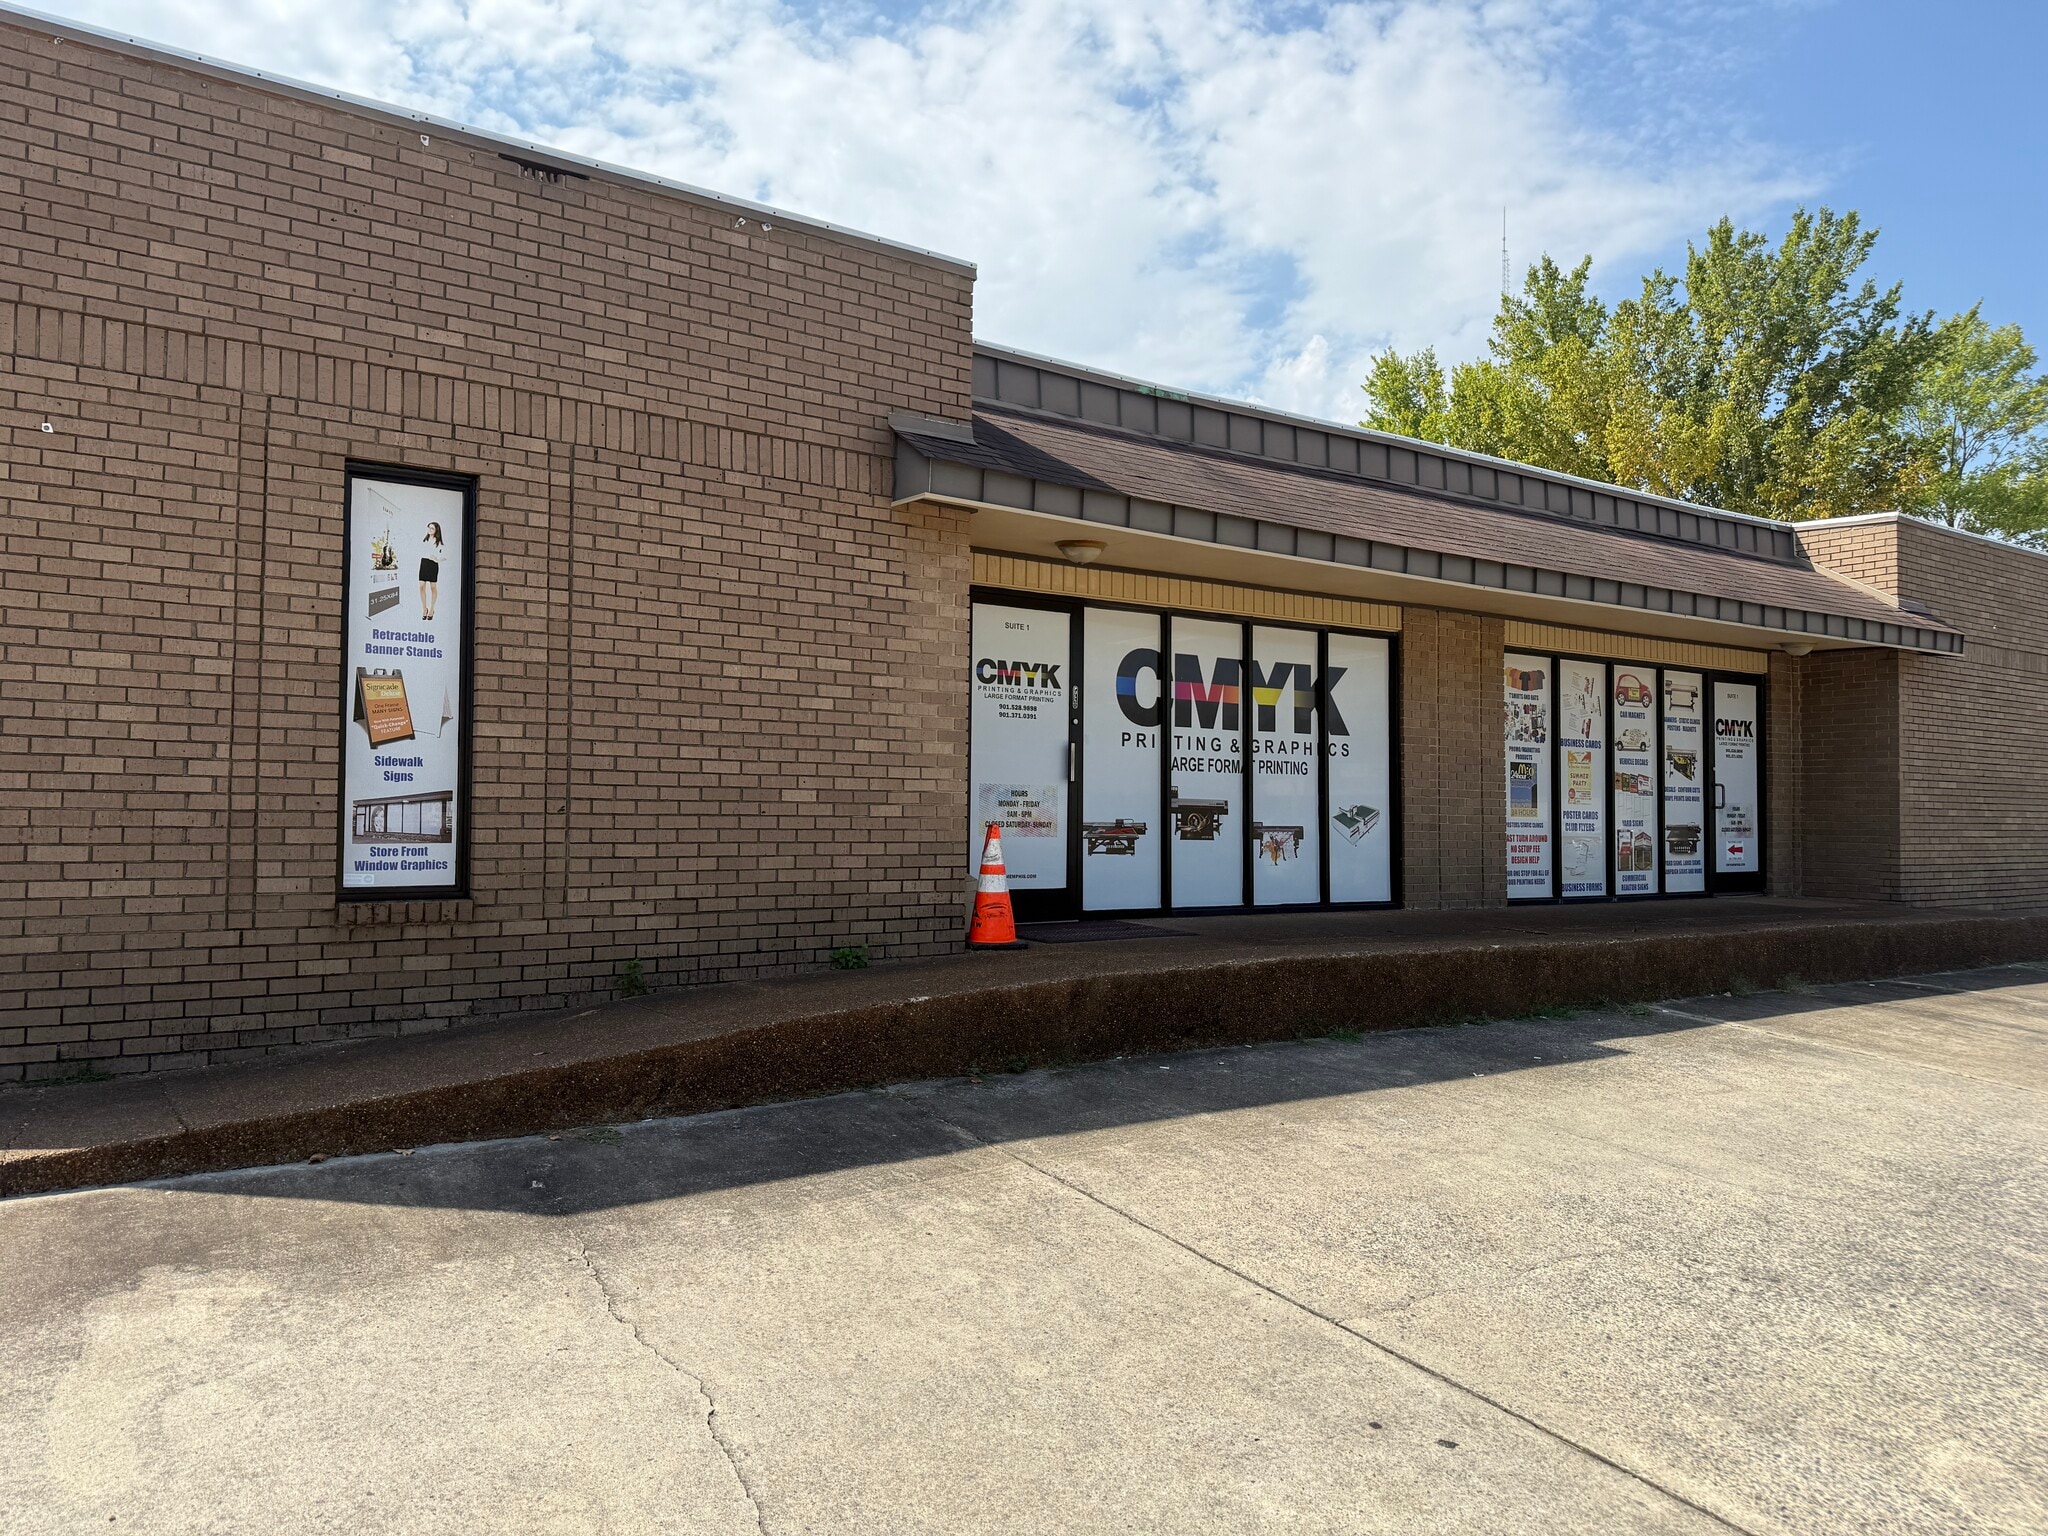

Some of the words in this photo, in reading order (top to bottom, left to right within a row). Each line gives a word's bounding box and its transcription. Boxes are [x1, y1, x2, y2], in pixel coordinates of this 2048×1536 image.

[1004, 622, 1025, 631] SUITE
[372, 628, 435, 643] Retractable
[365, 643, 405, 657] Banner
[406, 646, 443, 659] Stands
[976, 658, 1062, 689] CMYK
[366, 683, 399, 692] Signicade
[978, 685, 1015, 694] PRINTING
[1024, 688, 1062, 697] GRAPHICS
[1115, 647, 1351, 736] CMYK
[1628, 711, 1645, 719] MAGNETS
[1715, 718, 1753, 738] CMYK
[1121, 732, 1222, 752] PRITING
[1230, 738, 1241, 753] &
[1560, 738, 1584, 748] BUSINESS
[1585, 740, 1602, 749] CARDS
[374, 756, 424, 767] Sidewalk
[1171, 757, 1204, 772] ARGE
[1258, 760, 1308, 775] PRINTING
[1619, 758, 1634, 766] VEHICLE
[1635, 758, 1648, 766] DECALS
[383, 771, 414, 782] Signs
[1007, 810, 1018, 818] 9AM
[1518, 808, 1537, 817] HOURS
[1563, 811, 1581, 820] POSTER
[1582, 811, 1599, 820] CARDS
[1565, 822, 1578, 832] CLUB
[1579, 823, 1595, 832] FLYERS
[1506, 834, 1515, 842] AST
[1516, 834, 1528, 842] TURN
[370, 846, 399, 857] Store
[401, 846, 428, 857] Front
[1511, 845, 1517, 853] NO
[1518, 845, 1532, 853] SETUP
[1511, 856, 1528, 864] DESIGN
[1529, 856, 1540, 864] HELP
[354, 860, 398, 872] Window
[401, 860, 448, 872] Graphics
[1562, 883, 1585, 892] BUSINESS
[1586, 883, 1602, 891] FORMS
[1621, 883, 1637, 891] REALTOR
[1637, 883, 1648, 891] SIGNS
